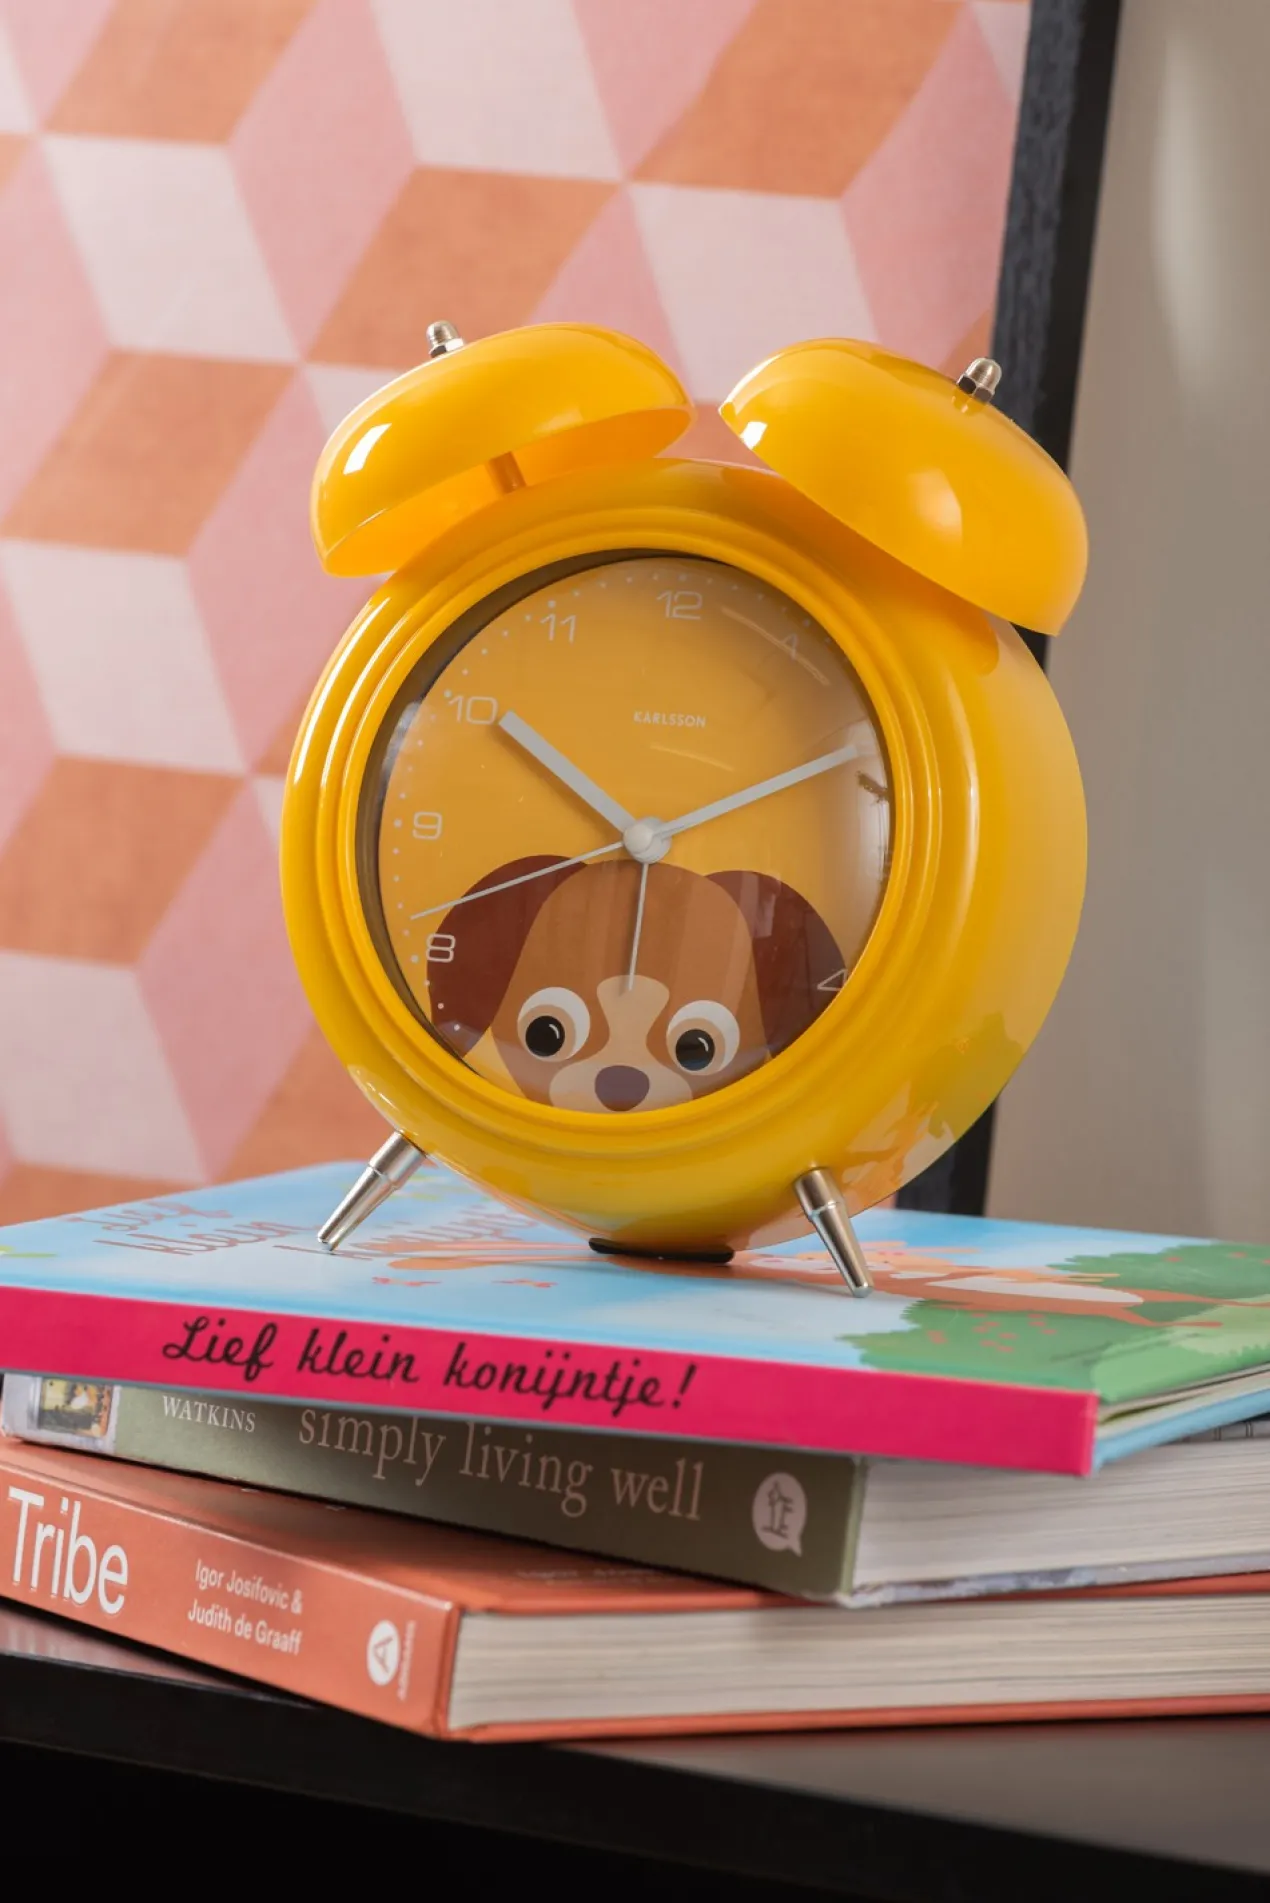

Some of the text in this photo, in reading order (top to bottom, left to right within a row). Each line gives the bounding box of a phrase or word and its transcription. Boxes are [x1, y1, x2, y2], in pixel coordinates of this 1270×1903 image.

[657, 589, 703, 621] 12
[539, 613, 578, 644] 11
[446, 694, 499, 726] 10
[633, 709, 707, 729] KARLSSON
[411, 811, 443, 840] 9
[425, 932, 456, 963] 8
[161, 1315, 698, 1418] Lief klein konijntje!
[162, 1394, 257, 1434] WATKINS
[298, 1407, 704, 1521] simply living well
[8, 1485, 129, 1615] Tribe
[195, 1557, 303, 1615] Igor Josifovic &
[187, 1598, 303, 1656] Judith de Graaff
